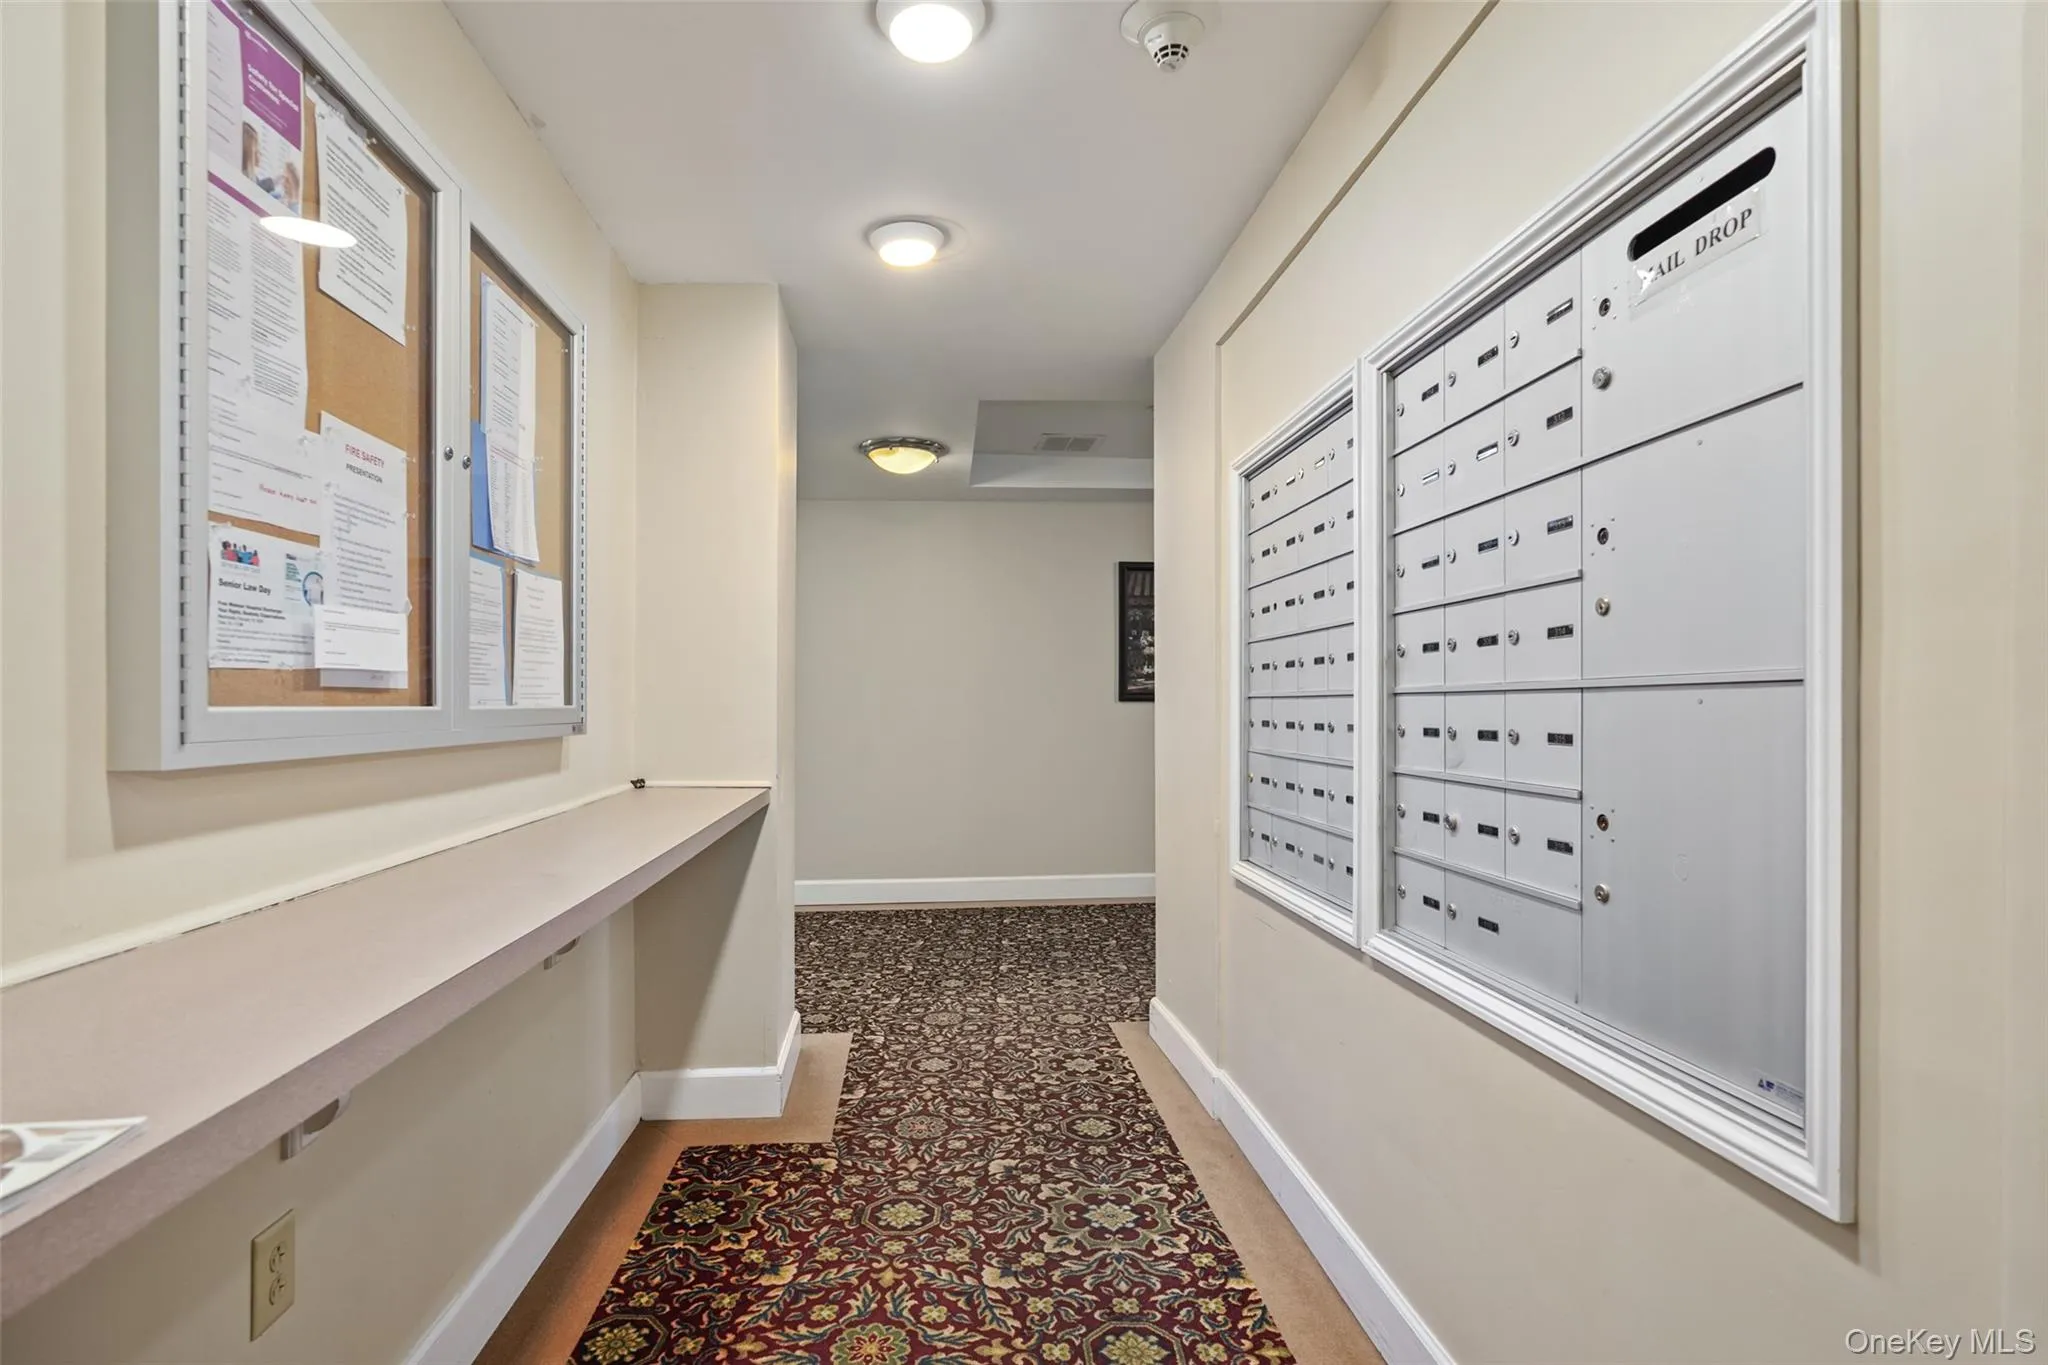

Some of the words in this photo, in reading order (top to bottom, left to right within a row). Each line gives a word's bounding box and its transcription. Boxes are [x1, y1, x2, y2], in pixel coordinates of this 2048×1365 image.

[1695, 208, 1753, 256] DROP
[345, 443, 361, 459] FIRE
[361, 451, 384, 468] SAFETY
[218, 577, 242, 589] Senior
[243, 581, 257, 592] Law
[258, 584, 272, 596] Day
